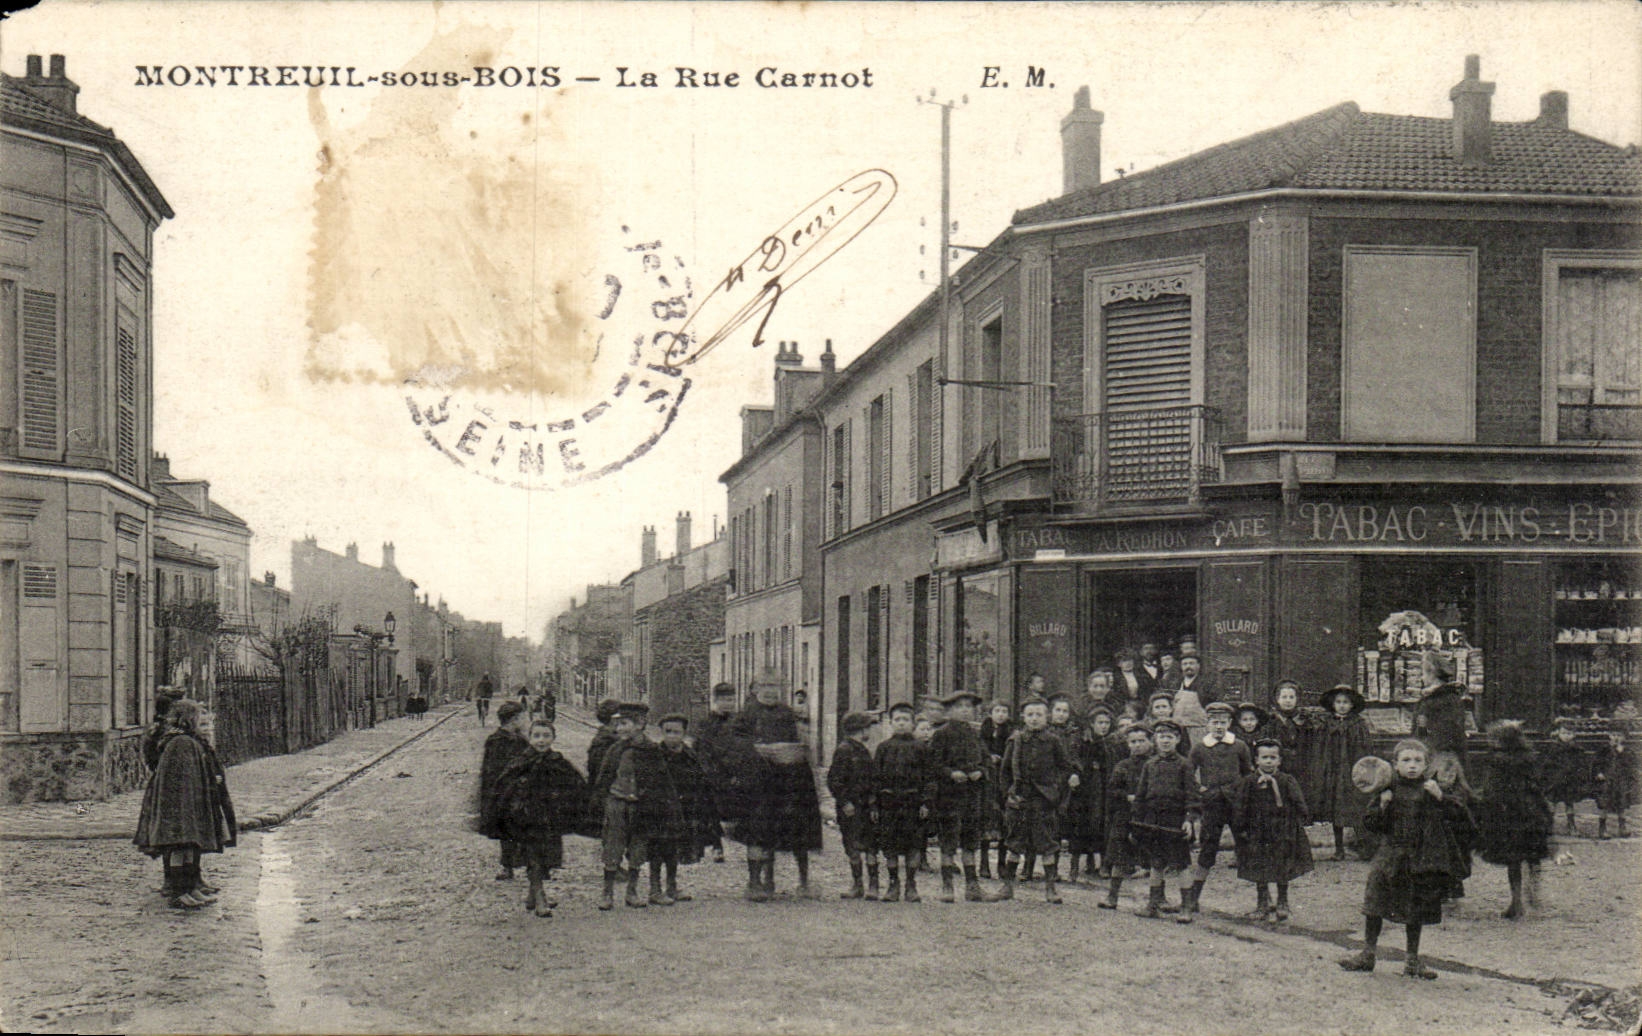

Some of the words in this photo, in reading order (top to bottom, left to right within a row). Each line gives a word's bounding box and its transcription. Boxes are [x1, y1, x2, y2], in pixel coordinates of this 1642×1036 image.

[1300, 502, 1428, 542] TABAC
[1450, 503, 1541, 543] VINS
[1215, 620, 1259, 635] BILLARD
[1386, 629, 1459, 647] TABAC
